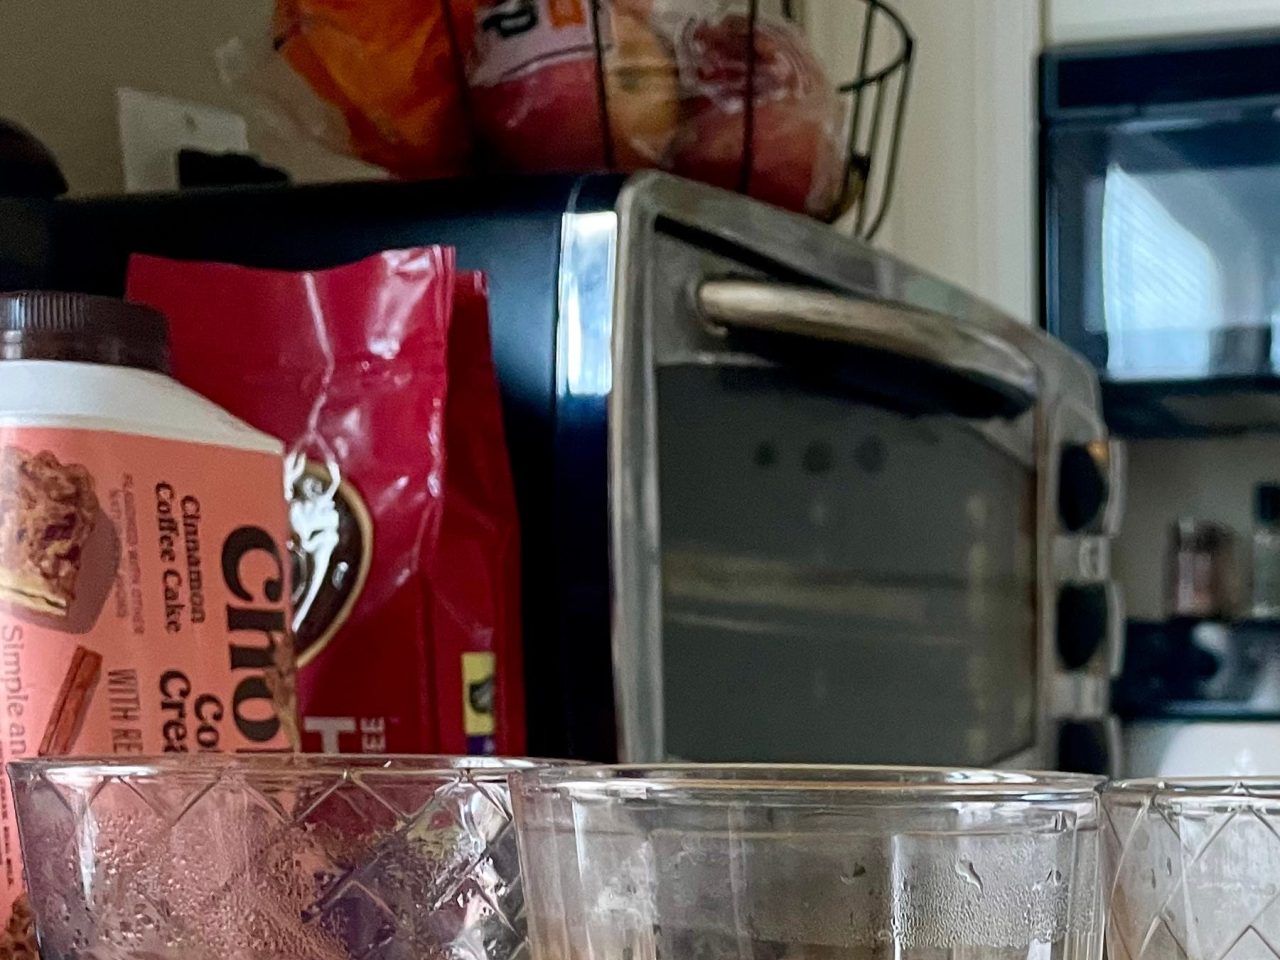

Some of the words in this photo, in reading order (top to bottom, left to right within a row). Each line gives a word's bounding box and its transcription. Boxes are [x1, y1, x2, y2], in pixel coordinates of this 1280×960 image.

[155, 480, 179, 563] Coffee
[179, 494, 205, 625] Cinnamon
[162, 568, 185, 635] Cake
[221, 523, 291, 753] Cho
[2, 624, 29, 717] Simple
[107, 668, 140, 721] WITH
[195, 692, 224, 753] Co
